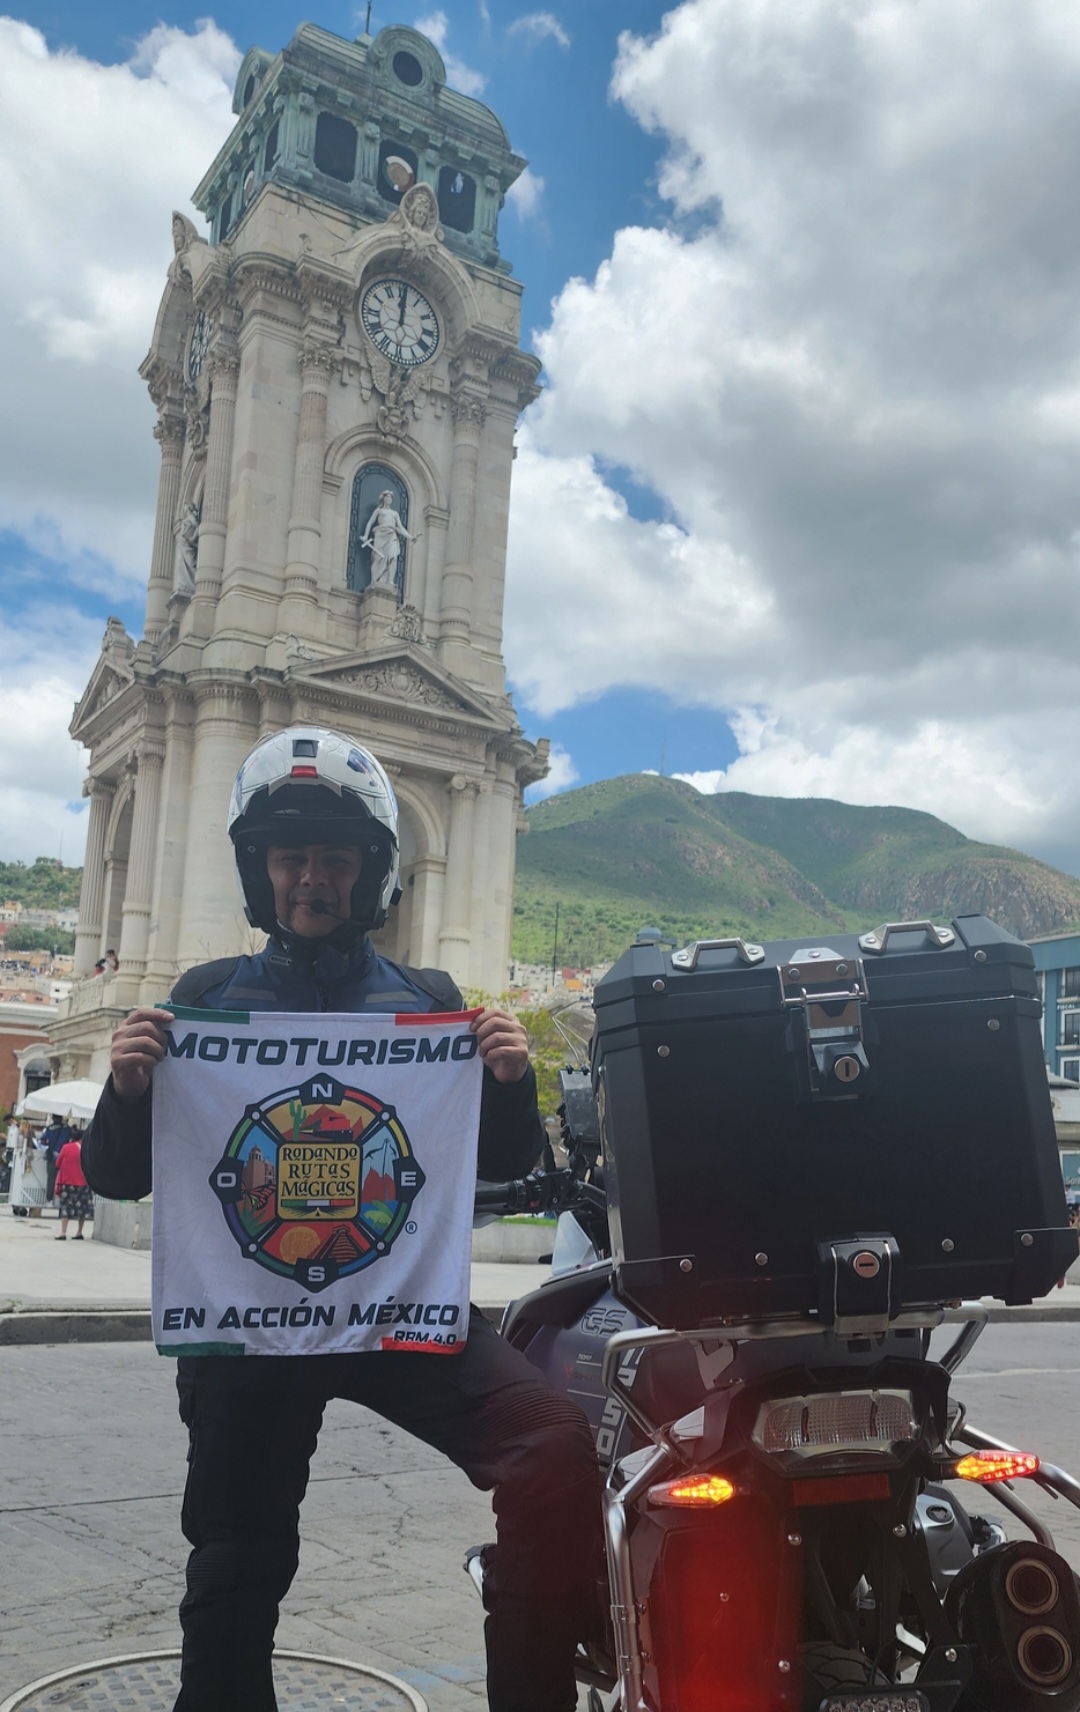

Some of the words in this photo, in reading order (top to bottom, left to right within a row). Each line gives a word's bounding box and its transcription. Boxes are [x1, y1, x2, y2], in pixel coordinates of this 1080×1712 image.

[163, 1030, 478, 1066] MOTOTURISMO
[312, 1083, 333, 1098] N
[216, 1173, 237, 1188] O
[401, 1171, 417, 1186] E
[308, 1267, 326, 1282] S
[162, 1307, 206, 1331] EN
[217, 1297, 336, 1330] ACCIÓN
[348, 1296, 460, 1327] MÉXICO
[580, 1307, 627, 1338] GS
[394, 1331, 430, 1342] RRM
[432, 1332, 457, 1345] 4.0
